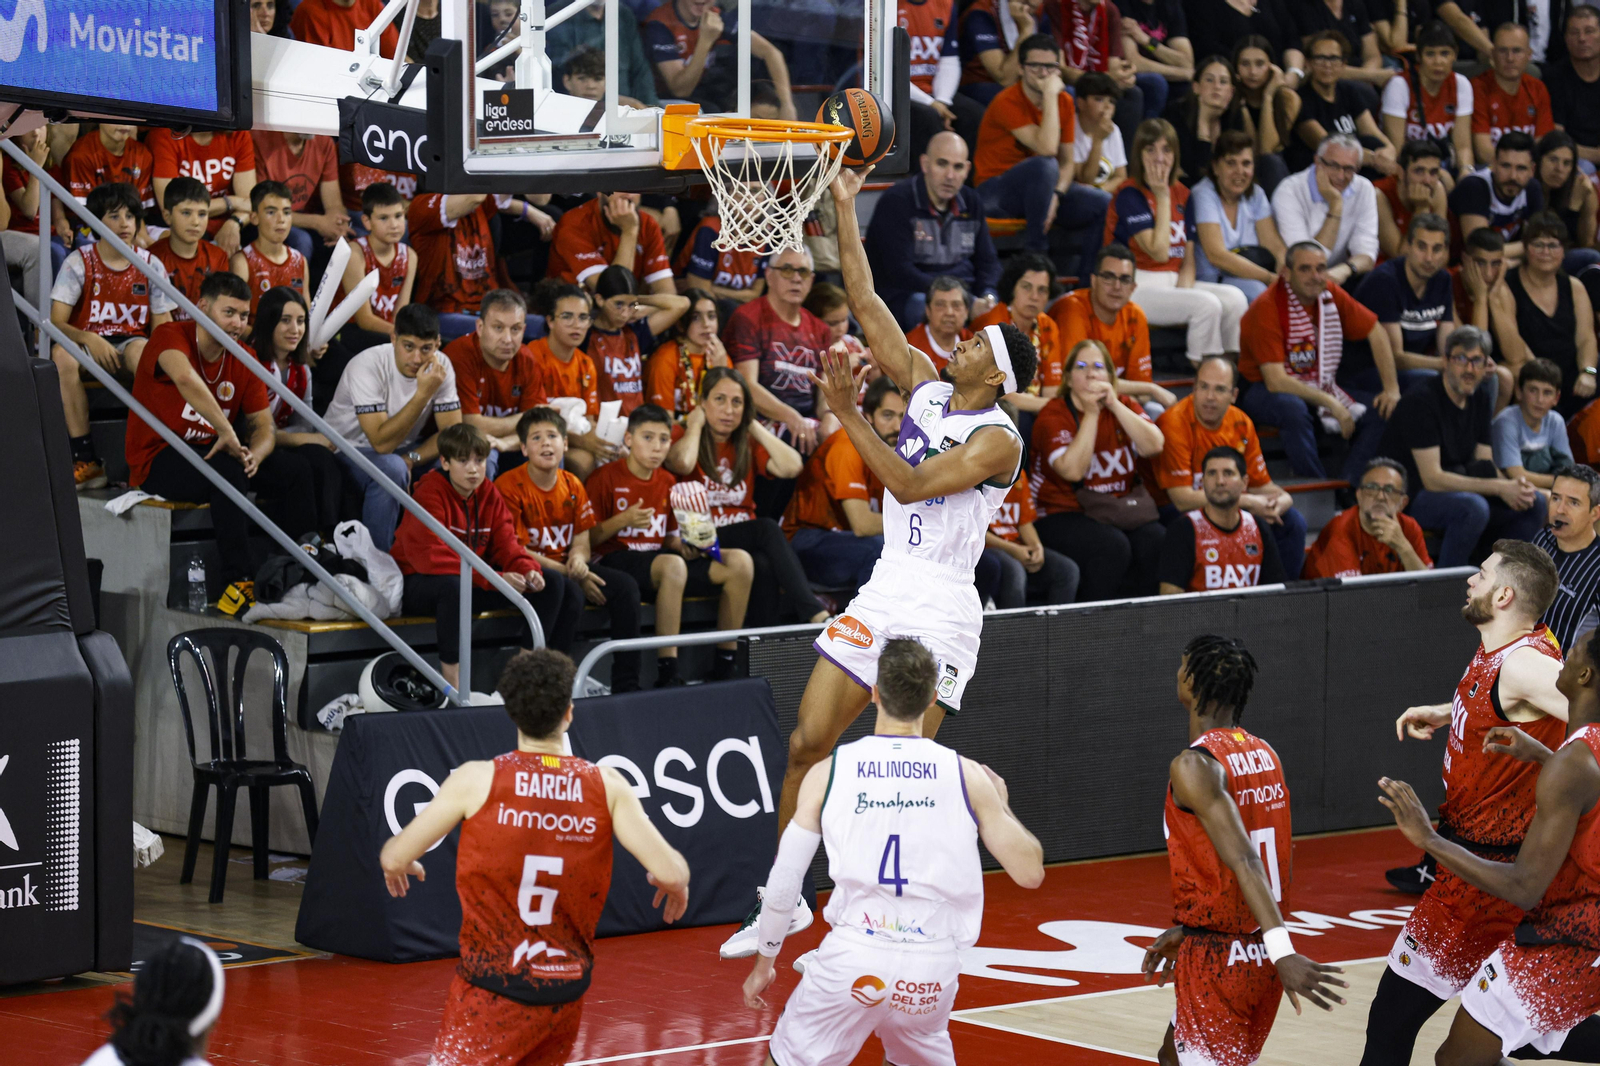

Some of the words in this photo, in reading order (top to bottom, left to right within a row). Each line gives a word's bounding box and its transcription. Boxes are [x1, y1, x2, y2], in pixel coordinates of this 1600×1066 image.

[69, 11, 205, 63] Movistar
[485, 103, 507, 122] liga
[485, 118, 532, 132] endesa
[850, 91, 876, 138] SPALDING
[179, 156, 236, 184] SAPS
[89, 300, 149, 327] BAXI
[1087, 445, 1134, 479] AXI
[526, 523, 574, 551] BAXI
[908, 513, 923, 547] 6
[1205, 564, 1261, 589] BAXI
[857, 761, 938, 780] KALINOSKI
[515, 770, 584, 803] GARCÍA
[498, 803, 597, 834] inmoovs
[878, 834, 909, 897] 4
[517, 854, 564, 926] 6
[861, 912, 926, 936] Andalucía
[891, 993, 916, 1005] DEL
[919, 994, 939, 1006] SOL
[895, 980, 943, 994] COSTA
